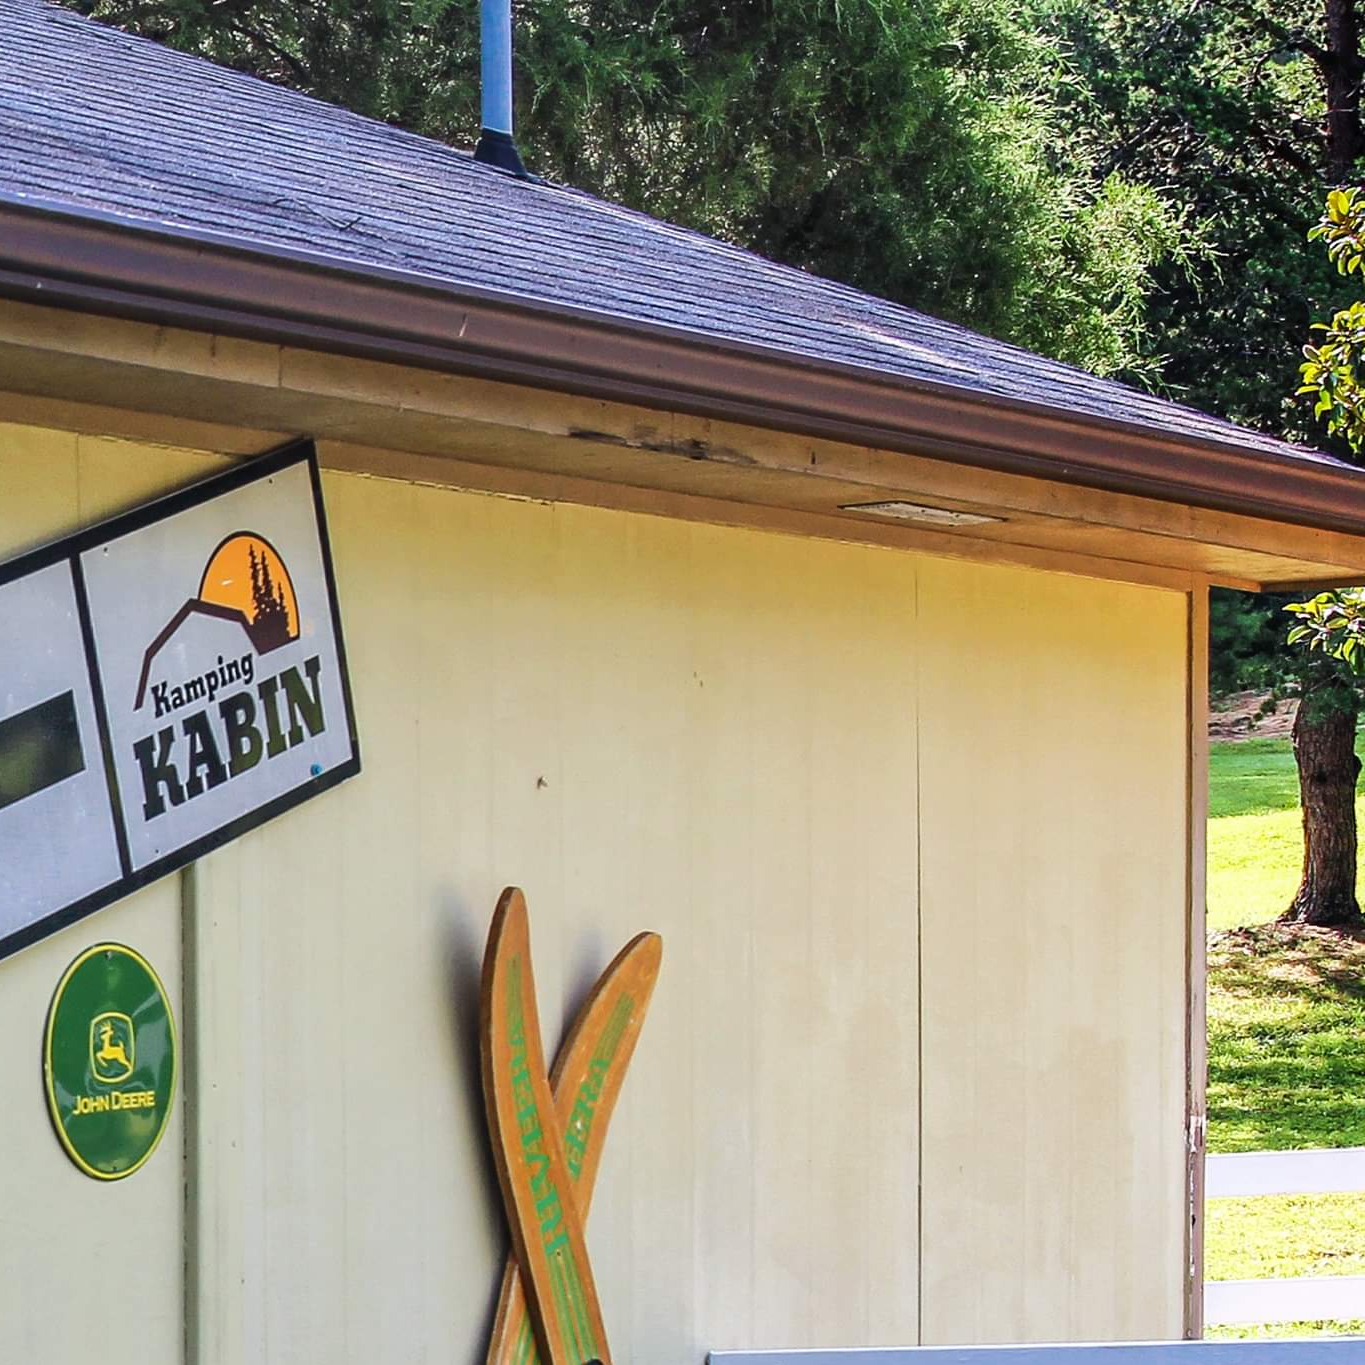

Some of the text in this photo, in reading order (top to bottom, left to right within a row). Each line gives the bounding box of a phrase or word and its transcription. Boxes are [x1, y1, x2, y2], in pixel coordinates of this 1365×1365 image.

[150, 652, 254, 718] Kamping
[132, 655, 326, 823] KABIN
[73, 1091, 155, 1115] JOHN DEERE
